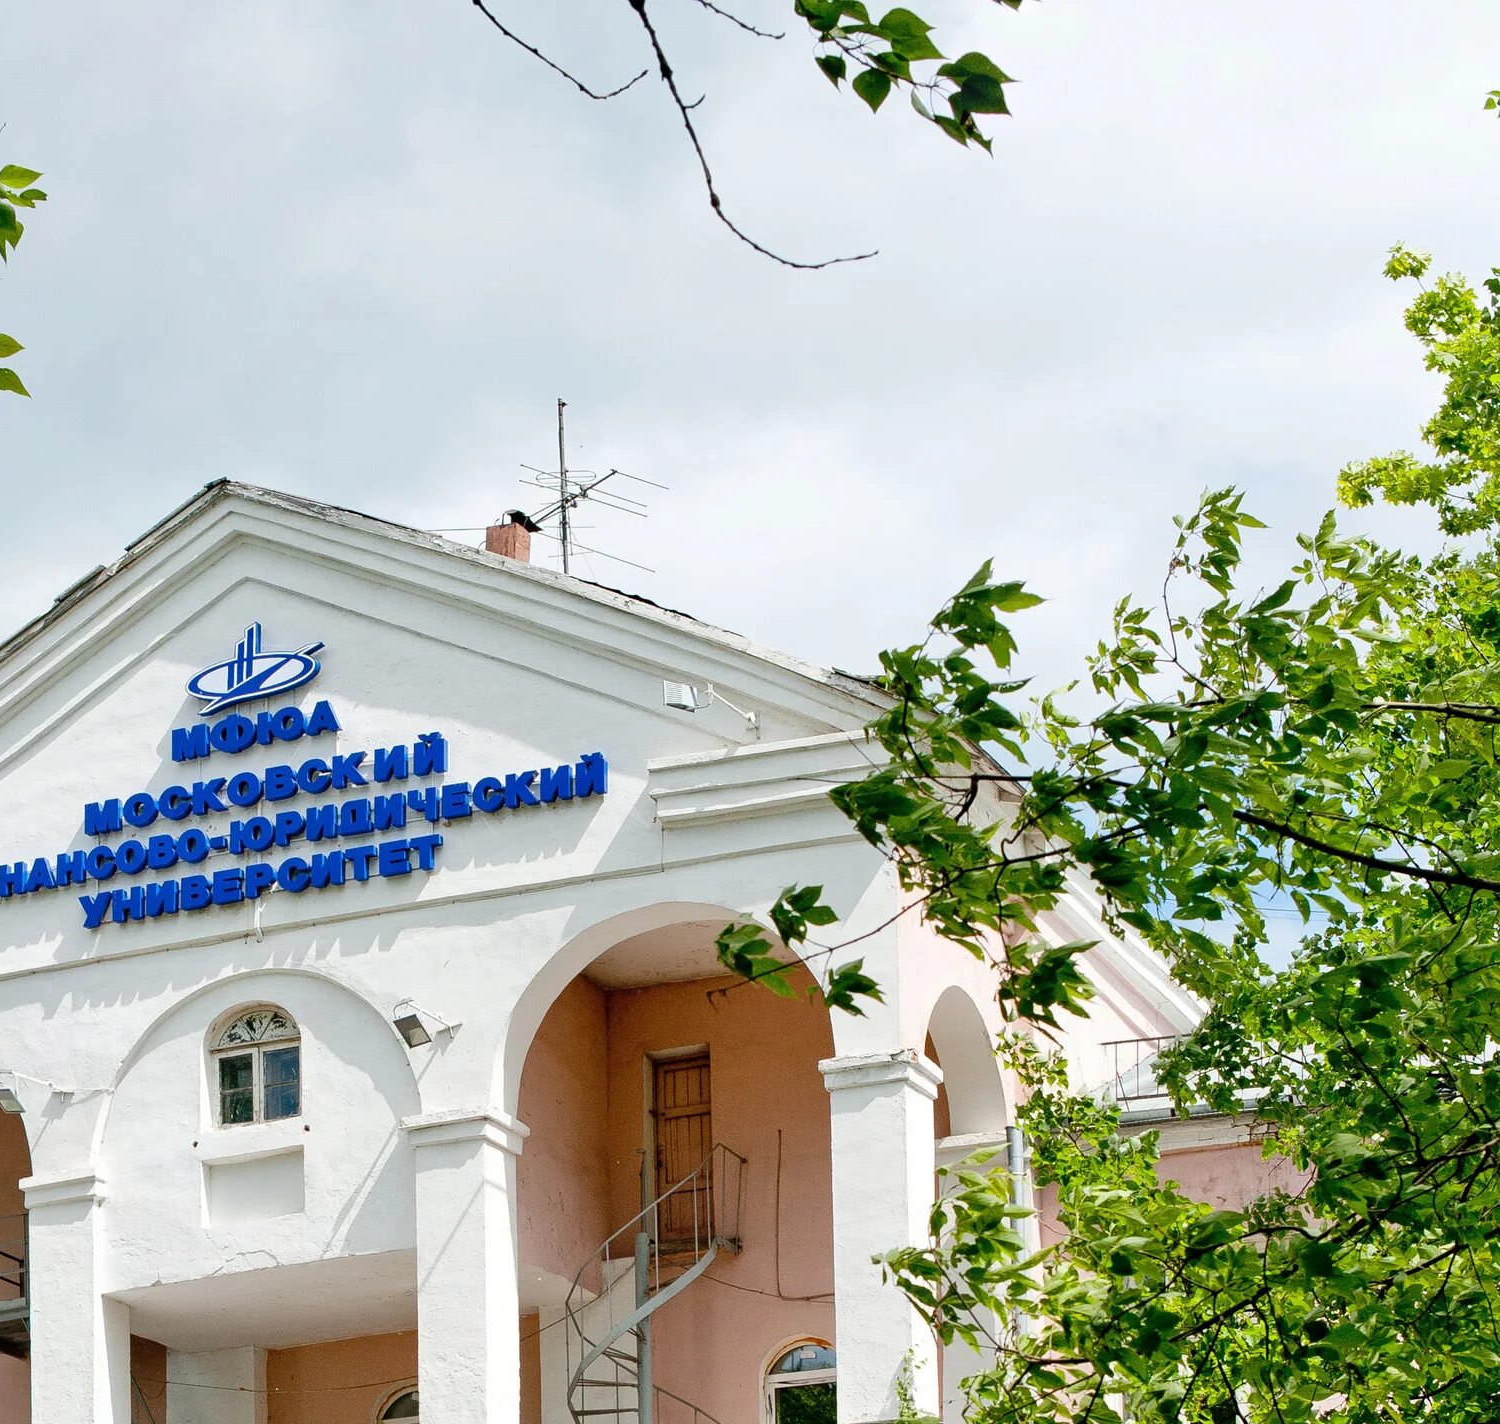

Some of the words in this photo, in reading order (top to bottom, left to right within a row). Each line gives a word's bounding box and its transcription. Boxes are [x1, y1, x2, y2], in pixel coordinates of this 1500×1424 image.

[172, 700, 341, 762] МФЮА
[84, 731, 448, 836] МОСКОВСКИЙ
[79, 834, 443, 929] УНИВЕРСИТЕТ
